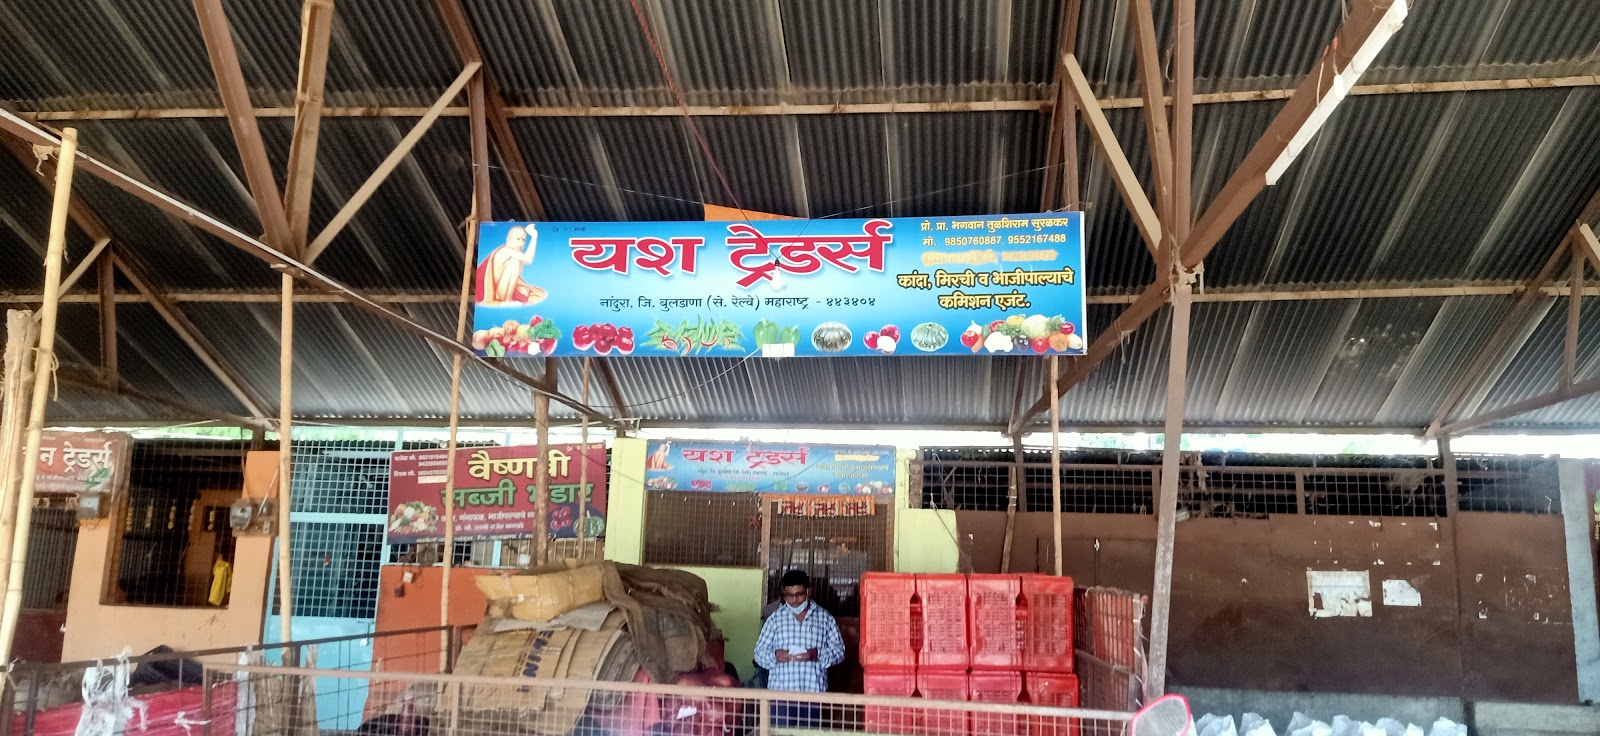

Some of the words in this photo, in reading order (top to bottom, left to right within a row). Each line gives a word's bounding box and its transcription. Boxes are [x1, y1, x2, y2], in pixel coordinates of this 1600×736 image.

[921, 220, 932, 231] प्रो.
[936, 221, 948, 231] प्रा.
[952, 219, 984, 230] भगवान
[987, 217, 1028, 232] तुळशिराम
[922, 236, 936, 246] मो.
[945, 236, 1004, 246] 9850760887,
[1008, 234, 1066, 244] 9552167488
[568, 236, 705, 277] यश
[725, 219, 893, 289] ट्रेडर्स
[898, 270, 931, 289] कांदा,
[935, 270, 975, 287] मिरची
[978, 272, 990, 287] व
[992, 266, 1075, 286] भाजीपाल्याचे
[638, 295, 654, 308] जि.
[660, 298, 702, 312] बुलडाणा
[732, 295, 760, 310] रेल्वे)
[764, 296, 809, 311] महाराष्ट्र
[826, 297, 876, 307] ४४३४०४
[938, 290, 992, 309] कमिशन
[994, 290, 1031, 310] एजंट.
[63, 441, 112, 473] ट्रेडर्स
[681, 448, 734, 465] यश
[441, 479, 516, 508] सब्जी
